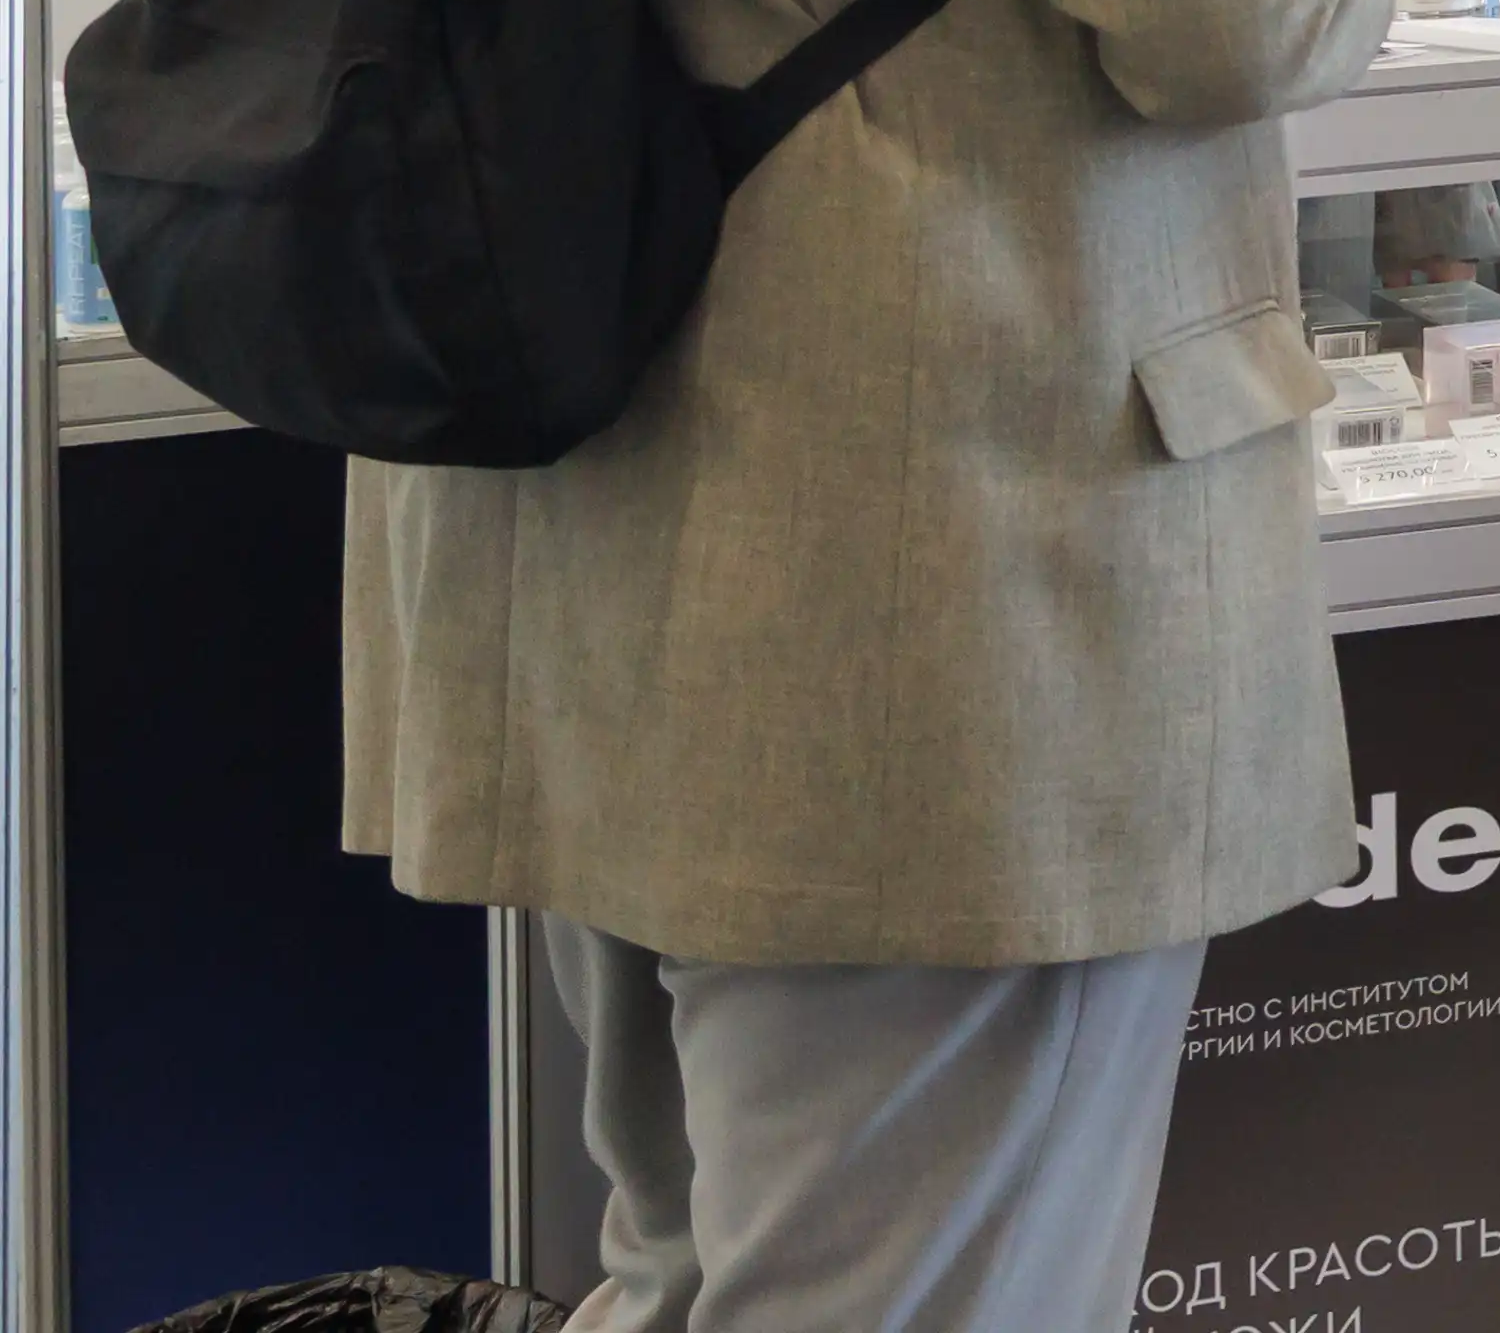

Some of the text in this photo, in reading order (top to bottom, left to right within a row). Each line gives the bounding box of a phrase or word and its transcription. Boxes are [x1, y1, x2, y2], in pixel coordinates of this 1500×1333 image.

[1185, 970, 1469, 1030] СТНО С ИНСТИТУТОМ
[1180, 1032, 1254, 1061] РГИИ
[1263, 1028, 1282, 1050] И
[1133, 1260, 1227, 1316] ОД
